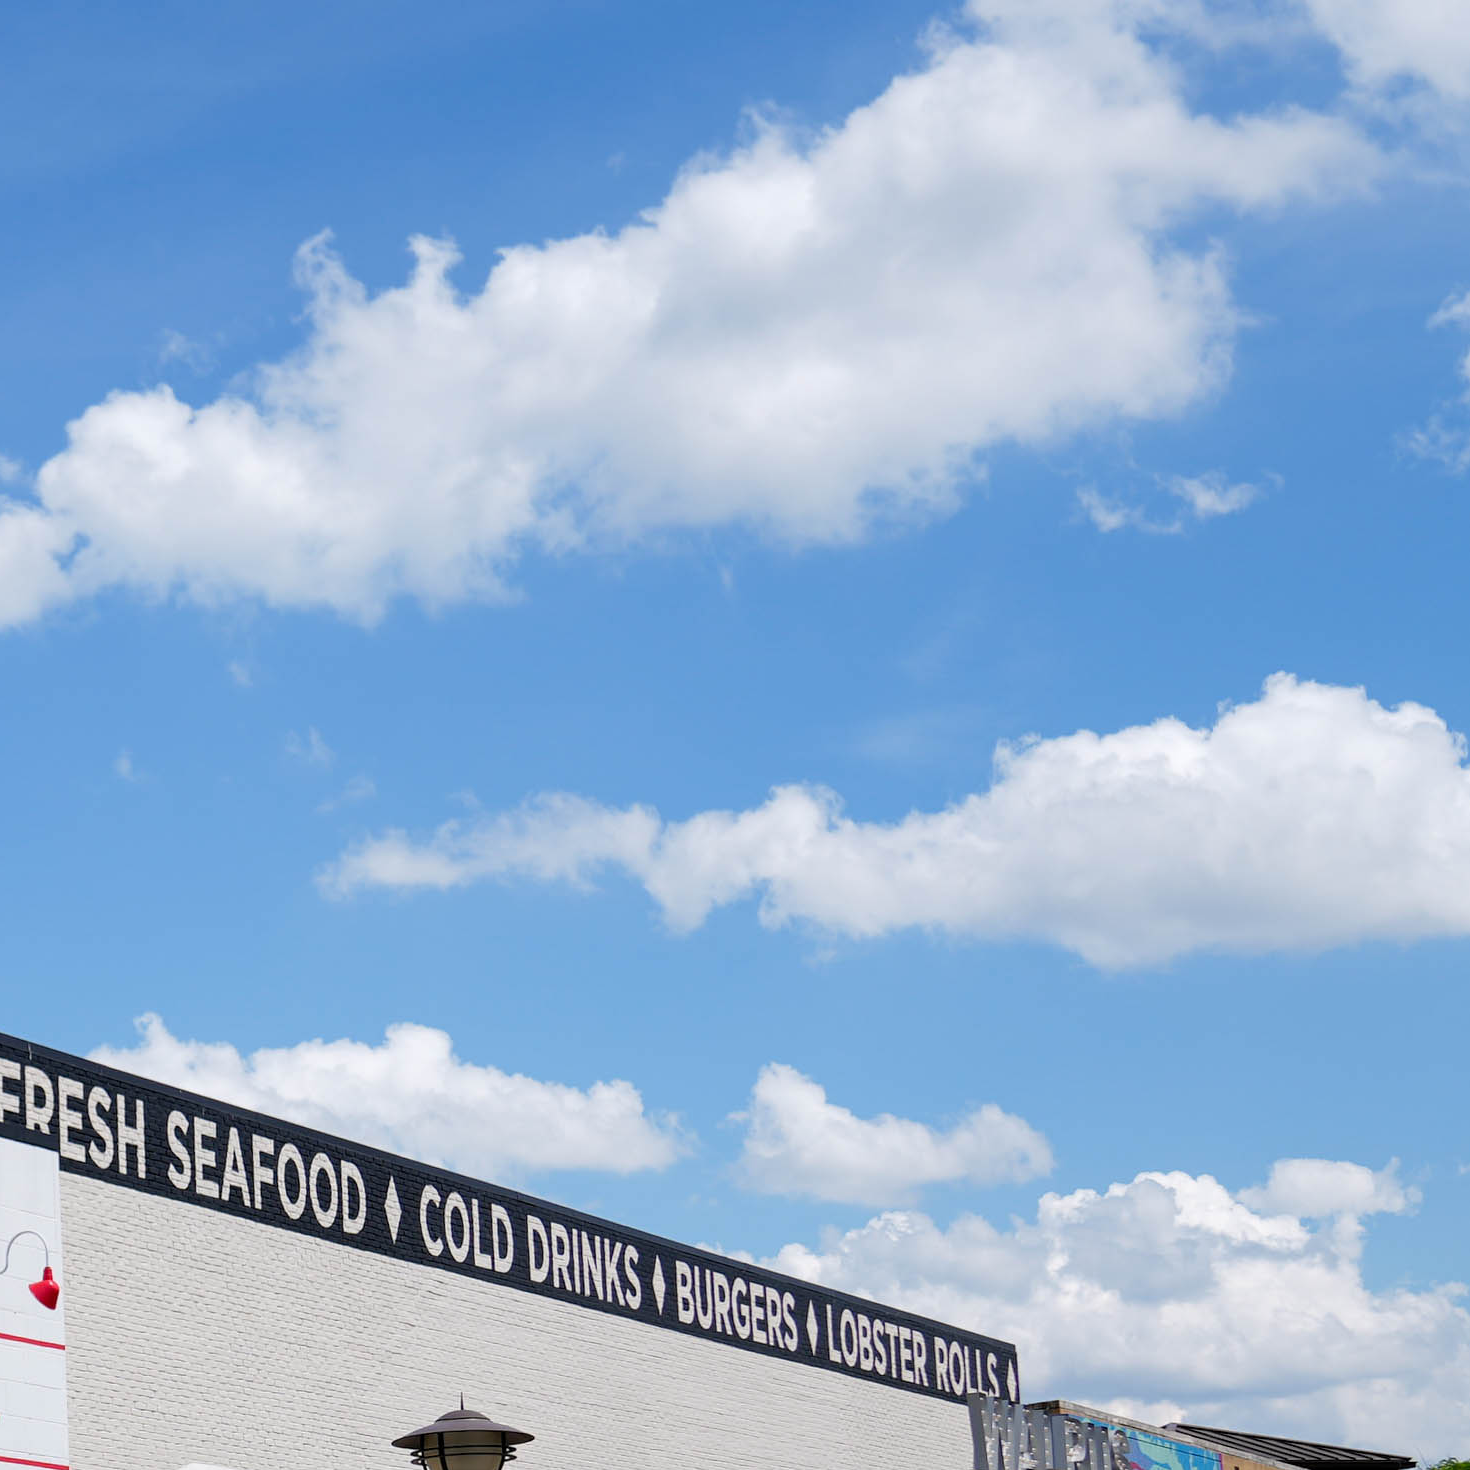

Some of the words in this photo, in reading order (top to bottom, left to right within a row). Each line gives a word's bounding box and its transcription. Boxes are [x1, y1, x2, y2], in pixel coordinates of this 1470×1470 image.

[166, 1110, 367, 1235] SEAFOOD
[419, 1184, 514, 1274] COLD
[526, 1214, 642, 1311] DRINKS
[674, 1260, 799, 1352] BURGERS
[826, 1303, 929, 1387] LOBSTER
[933, 1336, 1001, 1398] ROLLS
